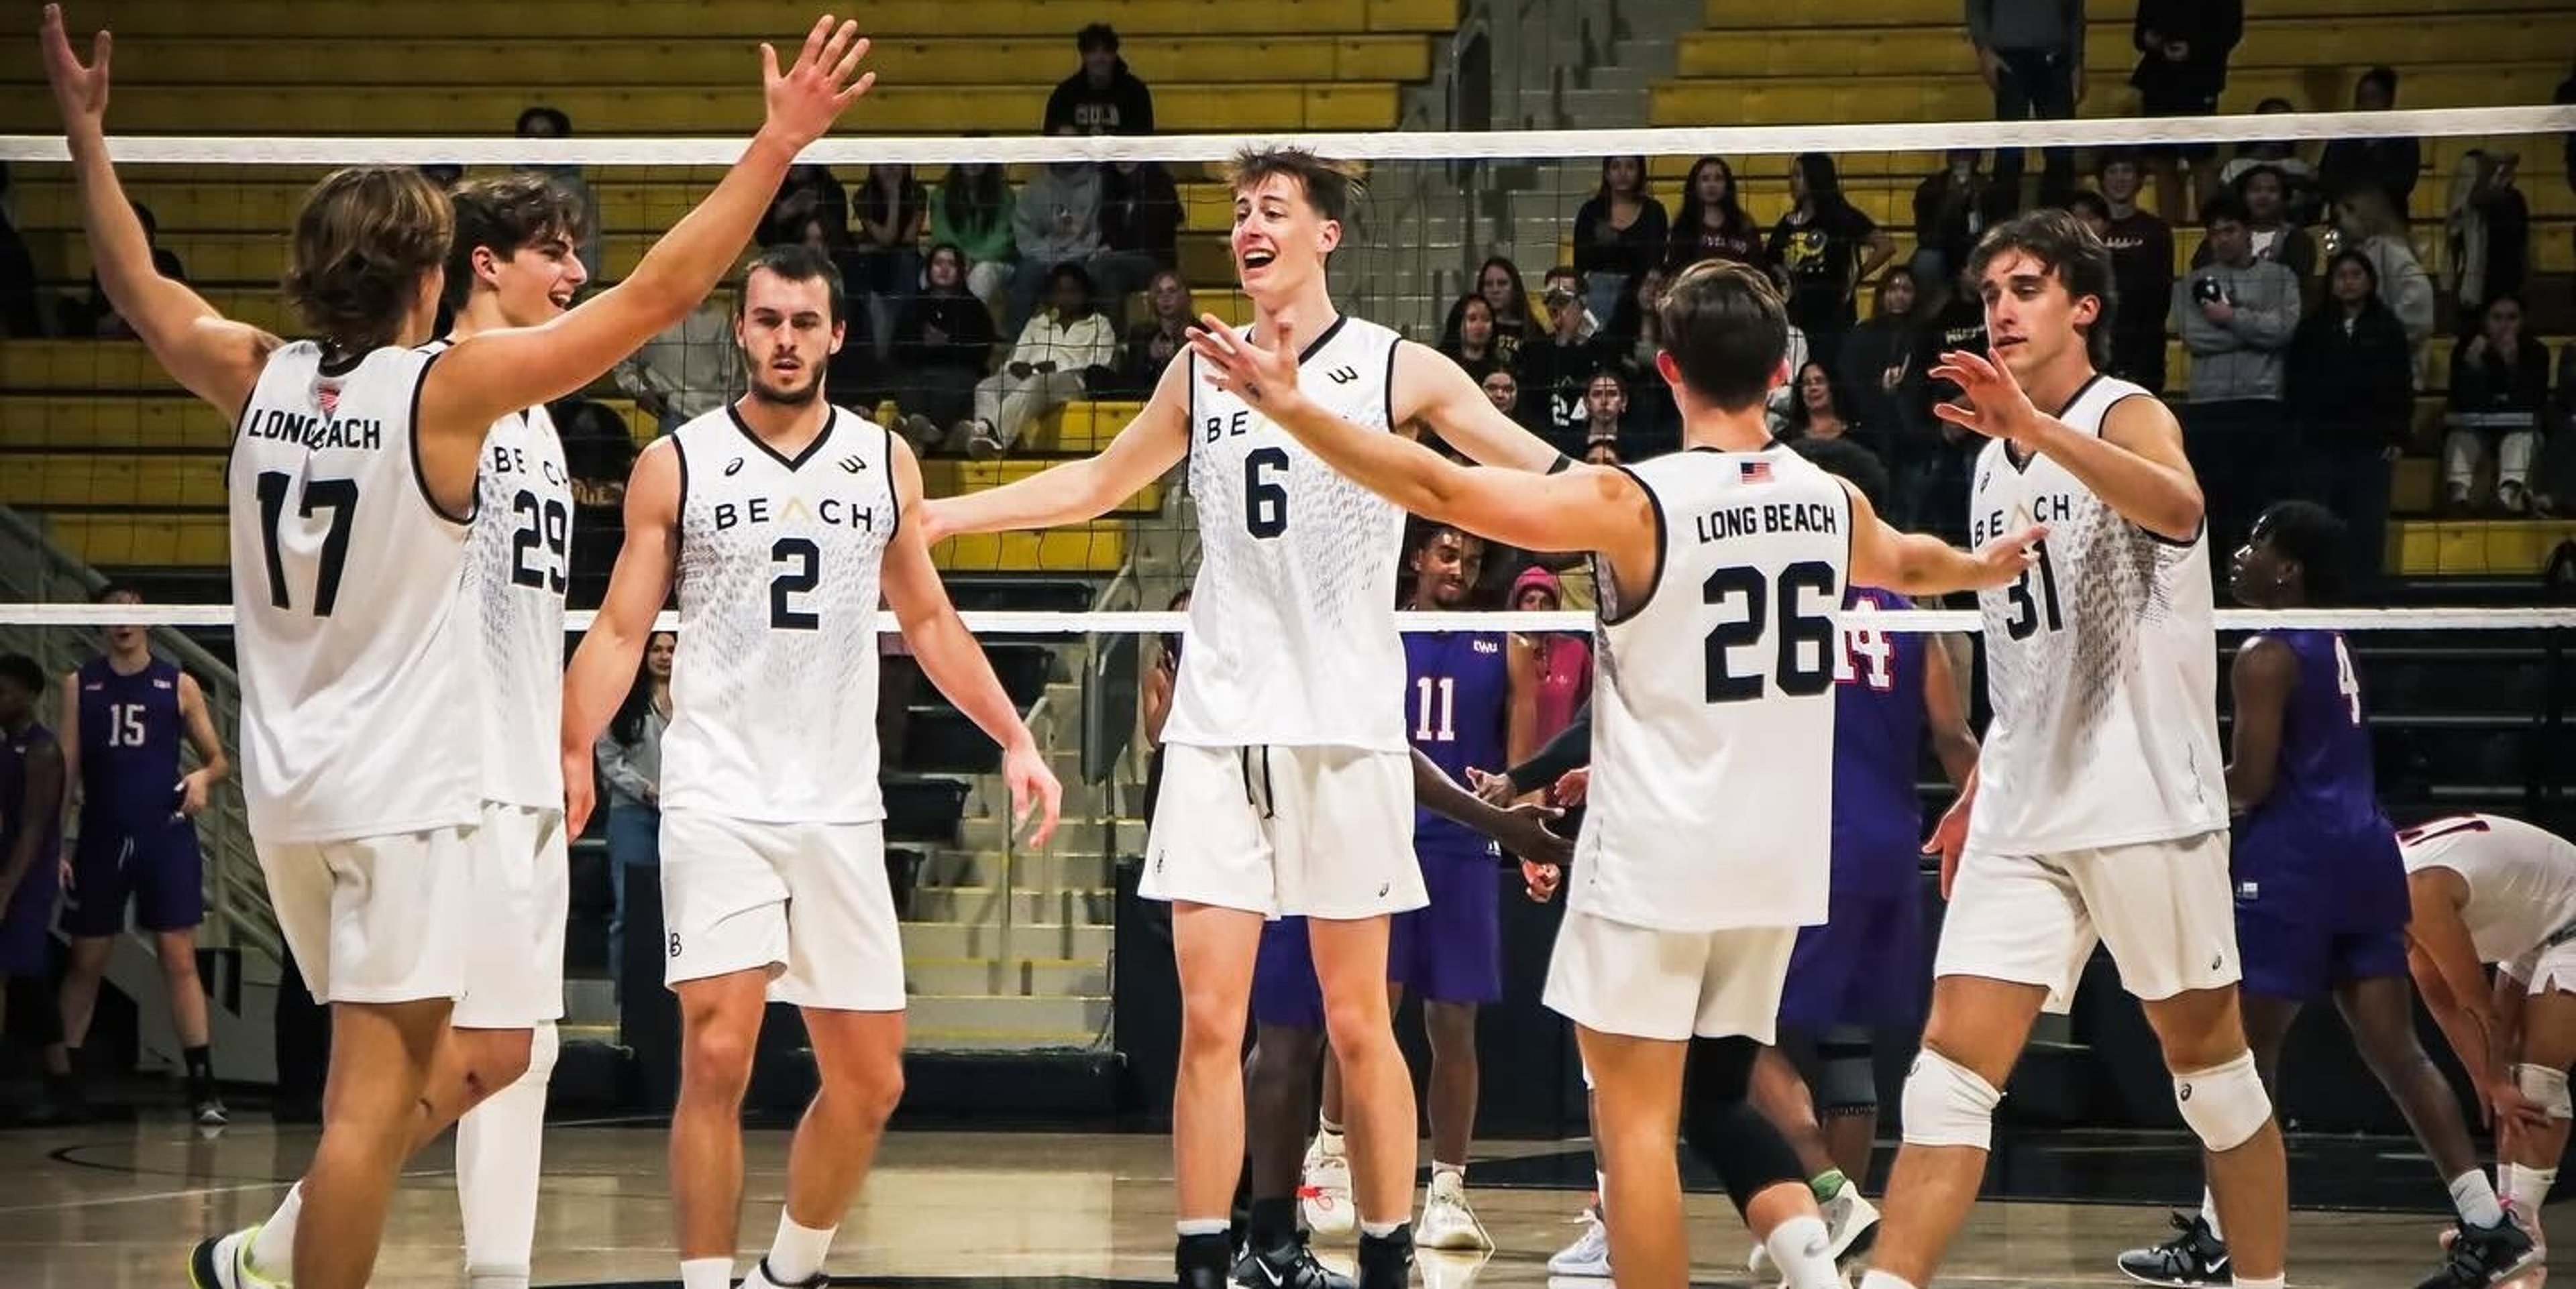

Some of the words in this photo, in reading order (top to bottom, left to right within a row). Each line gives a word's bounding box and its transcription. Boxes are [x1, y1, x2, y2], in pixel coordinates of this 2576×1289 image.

[715, 497, 872, 532] BEACH
[1245, 447, 1288, 539] 6
[1697, 507, 1756, 543] LONG
[1764, 504, 1836, 534] BEACH
[1975, 494, 2070, 547] BEACH
[256, 471, 358, 617] 17
[512, 489, 566, 594] 29
[771, 538, 820, 630] 2
[1703, 561, 1835, 704] 26
[2006, 539, 2063, 640] 31
[109, 704, 146, 747] 15
[1416, 677, 1455, 741] 11
